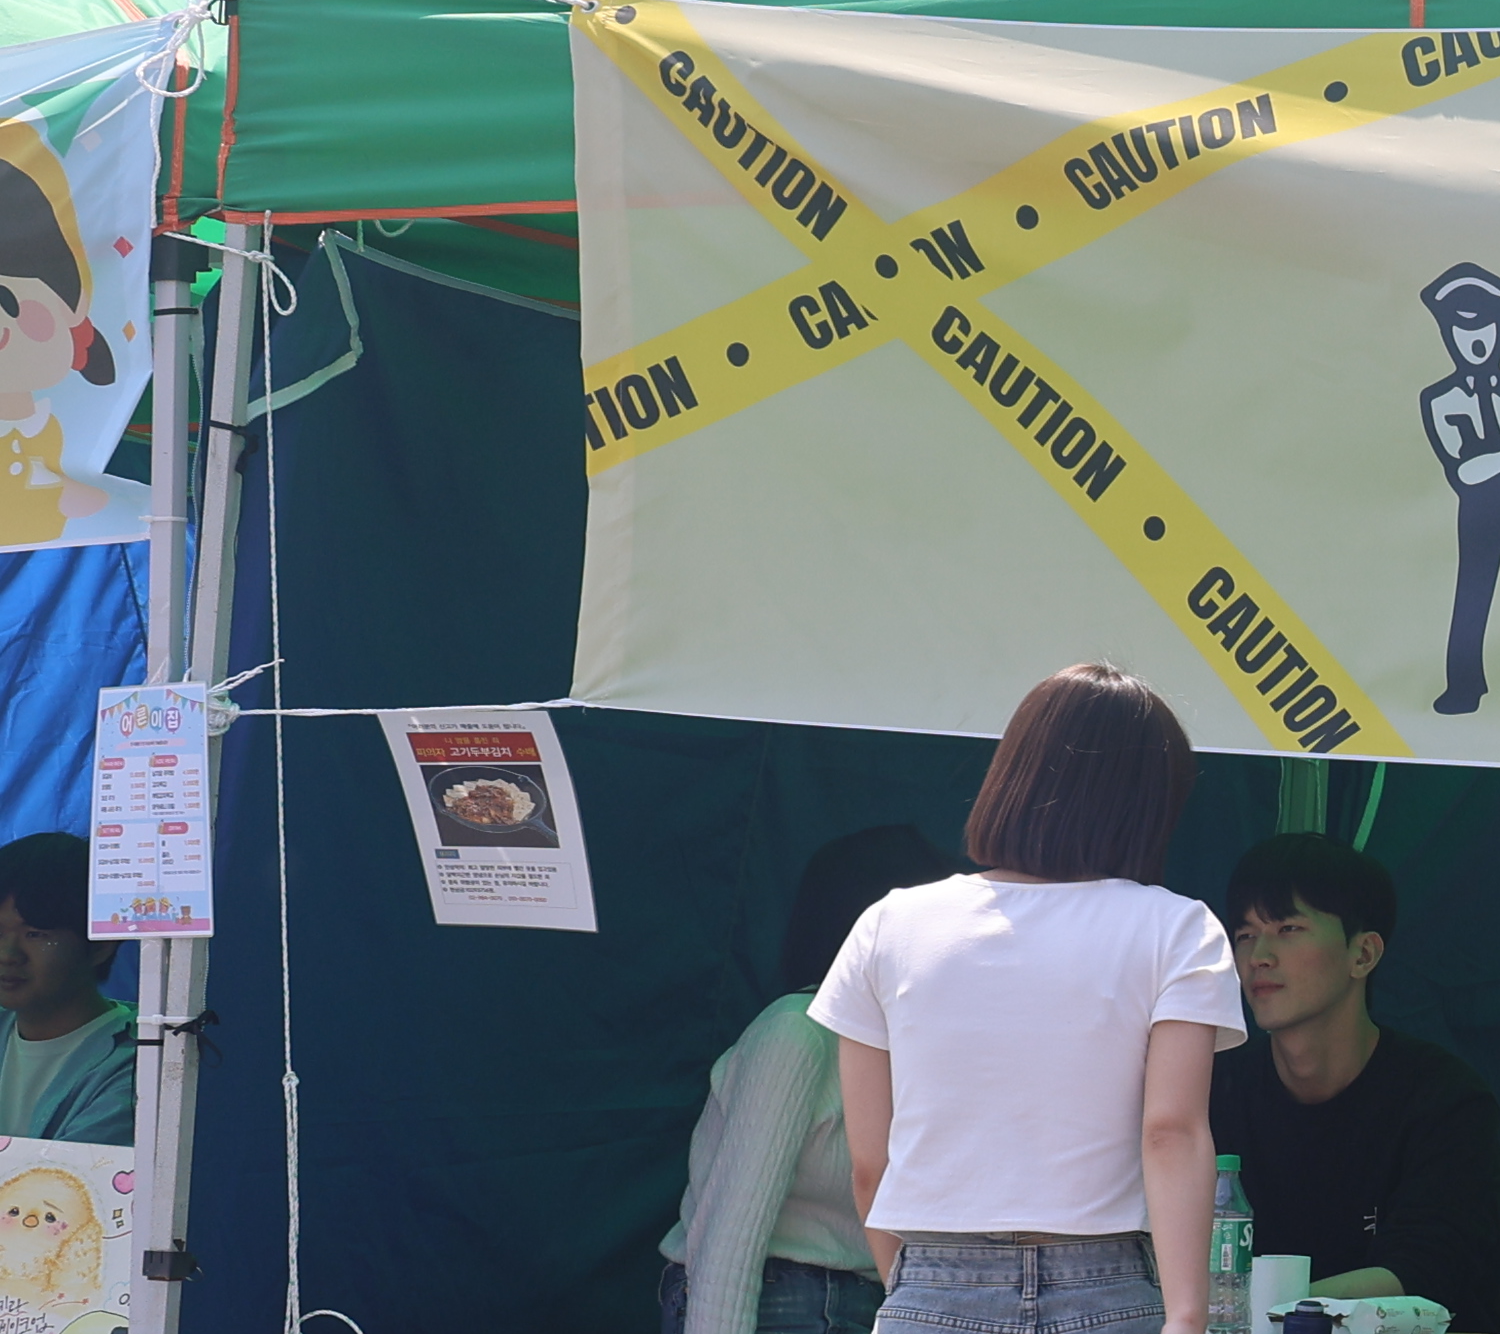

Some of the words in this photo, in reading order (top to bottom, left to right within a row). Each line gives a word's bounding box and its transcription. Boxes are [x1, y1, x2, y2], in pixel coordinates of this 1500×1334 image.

[660, 50, 846, 240] CAUTION
[1062, 92, 1278, 212] CAUTION
[929, 306, 1127, 502] CAUTION
[121, 706, 179, 733] 어른이집
[1186, 565, 1360, 755] CAUTION
[449, 747, 512, 758] 고기두부김치
